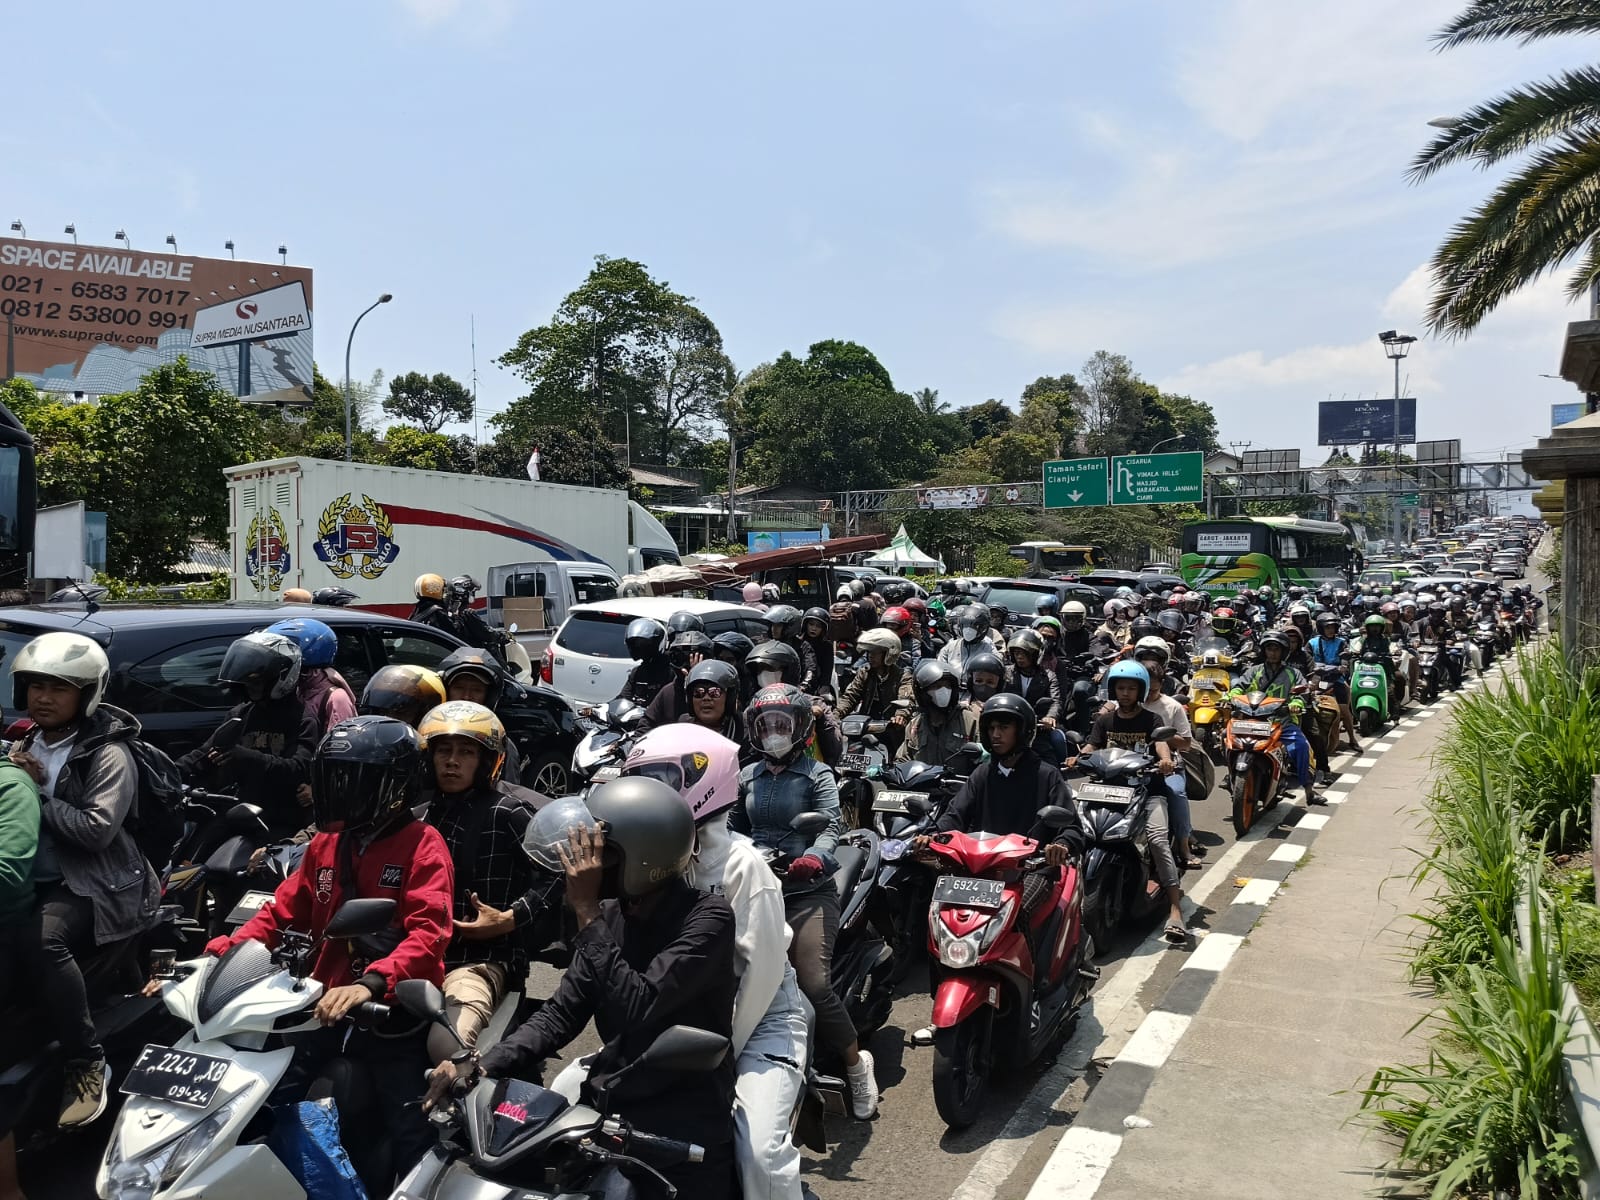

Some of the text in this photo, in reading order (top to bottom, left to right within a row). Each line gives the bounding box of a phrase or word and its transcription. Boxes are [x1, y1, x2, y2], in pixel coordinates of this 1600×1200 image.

[0, 244, 194, 282] SPACE AVAILABLE
[1, 274, 44, 294] 021
[71, 281, 127, 301] 6583
[135, 287, 190, 306] 7017
[0, 298, 189, 329] 0812 53800 991
[14, 325, 158, 345] www.supradv.com
[194, 314, 305, 344] SUPRA MEDIA NUSANTARA
[1048, 475, 1080, 484] Cianjur
[1077, 462, 1103, 471] Safari
[692, 786, 715, 814] NJS
[937, 878, 946, 888] F
[953, 879, 980, 892] 6924
[244, 896, 254, 907] F
[135, 1048, 228, 1082] F 2243 XB
